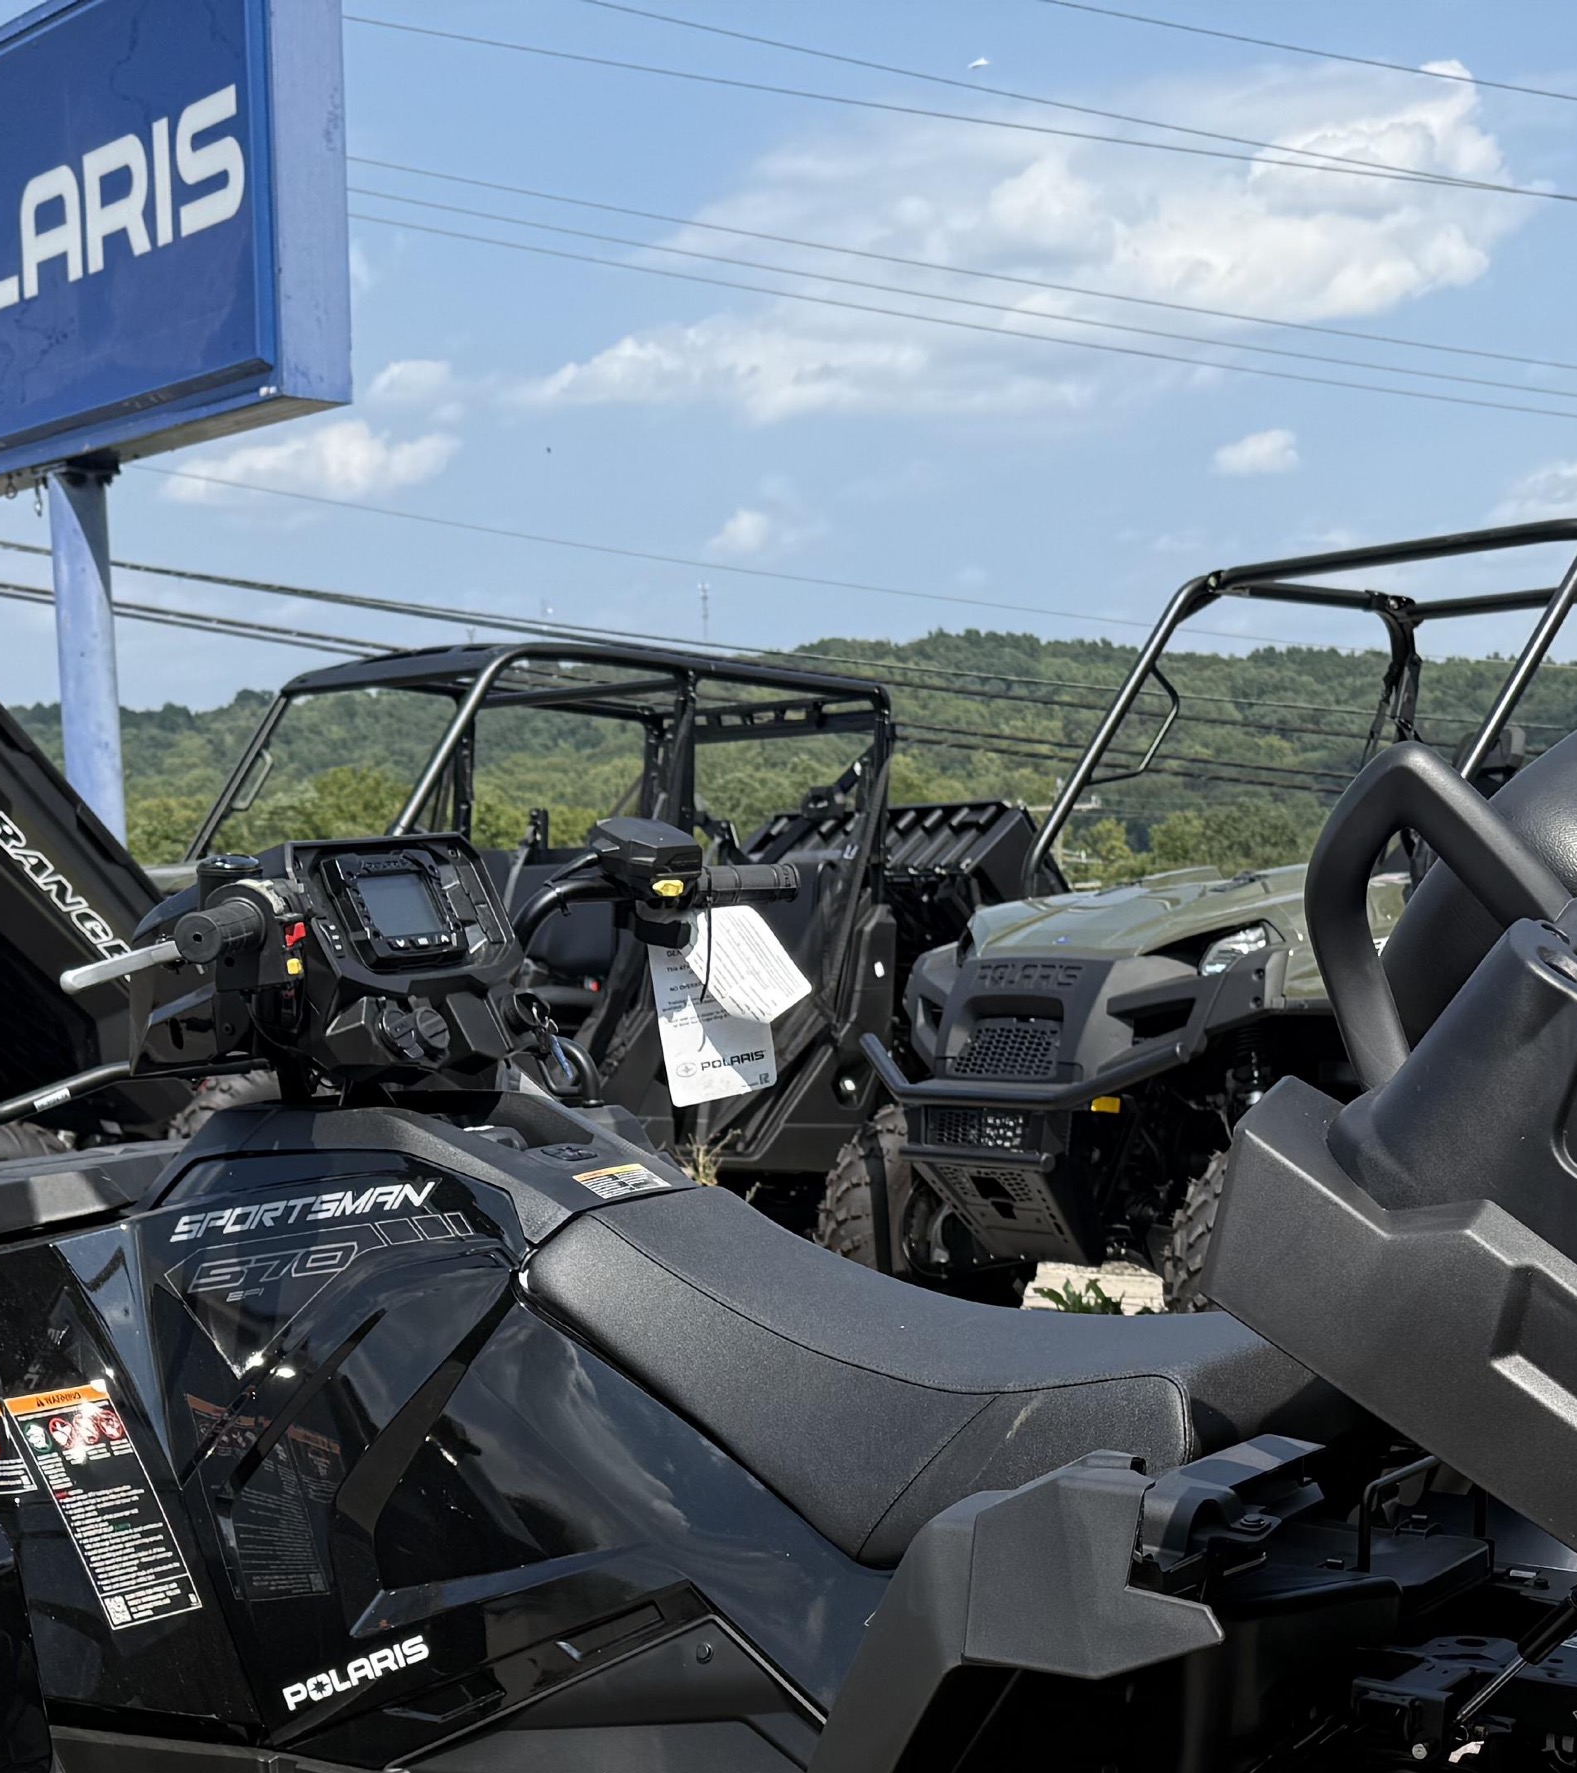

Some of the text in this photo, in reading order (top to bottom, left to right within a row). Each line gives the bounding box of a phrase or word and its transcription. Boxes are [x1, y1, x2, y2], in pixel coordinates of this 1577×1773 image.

[701, 1050, 765, 1071] POLARIS
[169, 1180, 438, 1243] SPORTSMAN
[187, 1241, 358, 1294] 570
[282, 1634, 430, 1711] POLARIS
